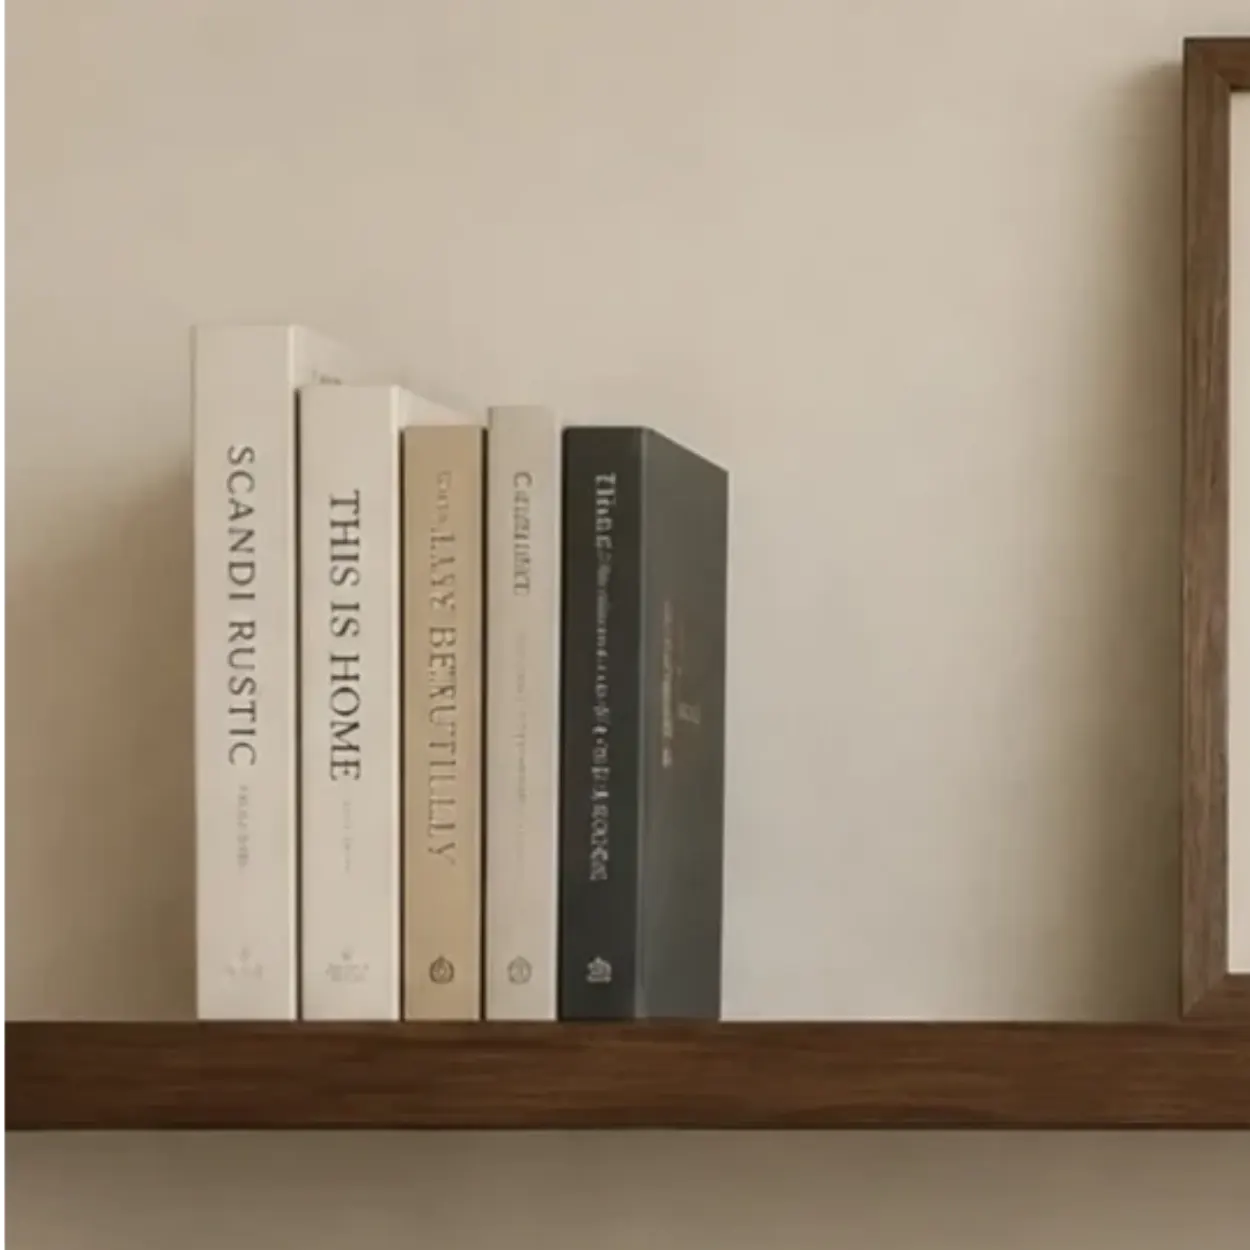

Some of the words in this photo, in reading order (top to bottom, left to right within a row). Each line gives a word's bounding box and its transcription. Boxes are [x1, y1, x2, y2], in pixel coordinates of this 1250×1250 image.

[226, 444, 256, 602] SCANDI
[329, 489, 361, 588] THIS
[329, 601, 361, 638] IS
[227, 619, 257, 766] RUSTIC
[329, 651, 362, 783] HOME
